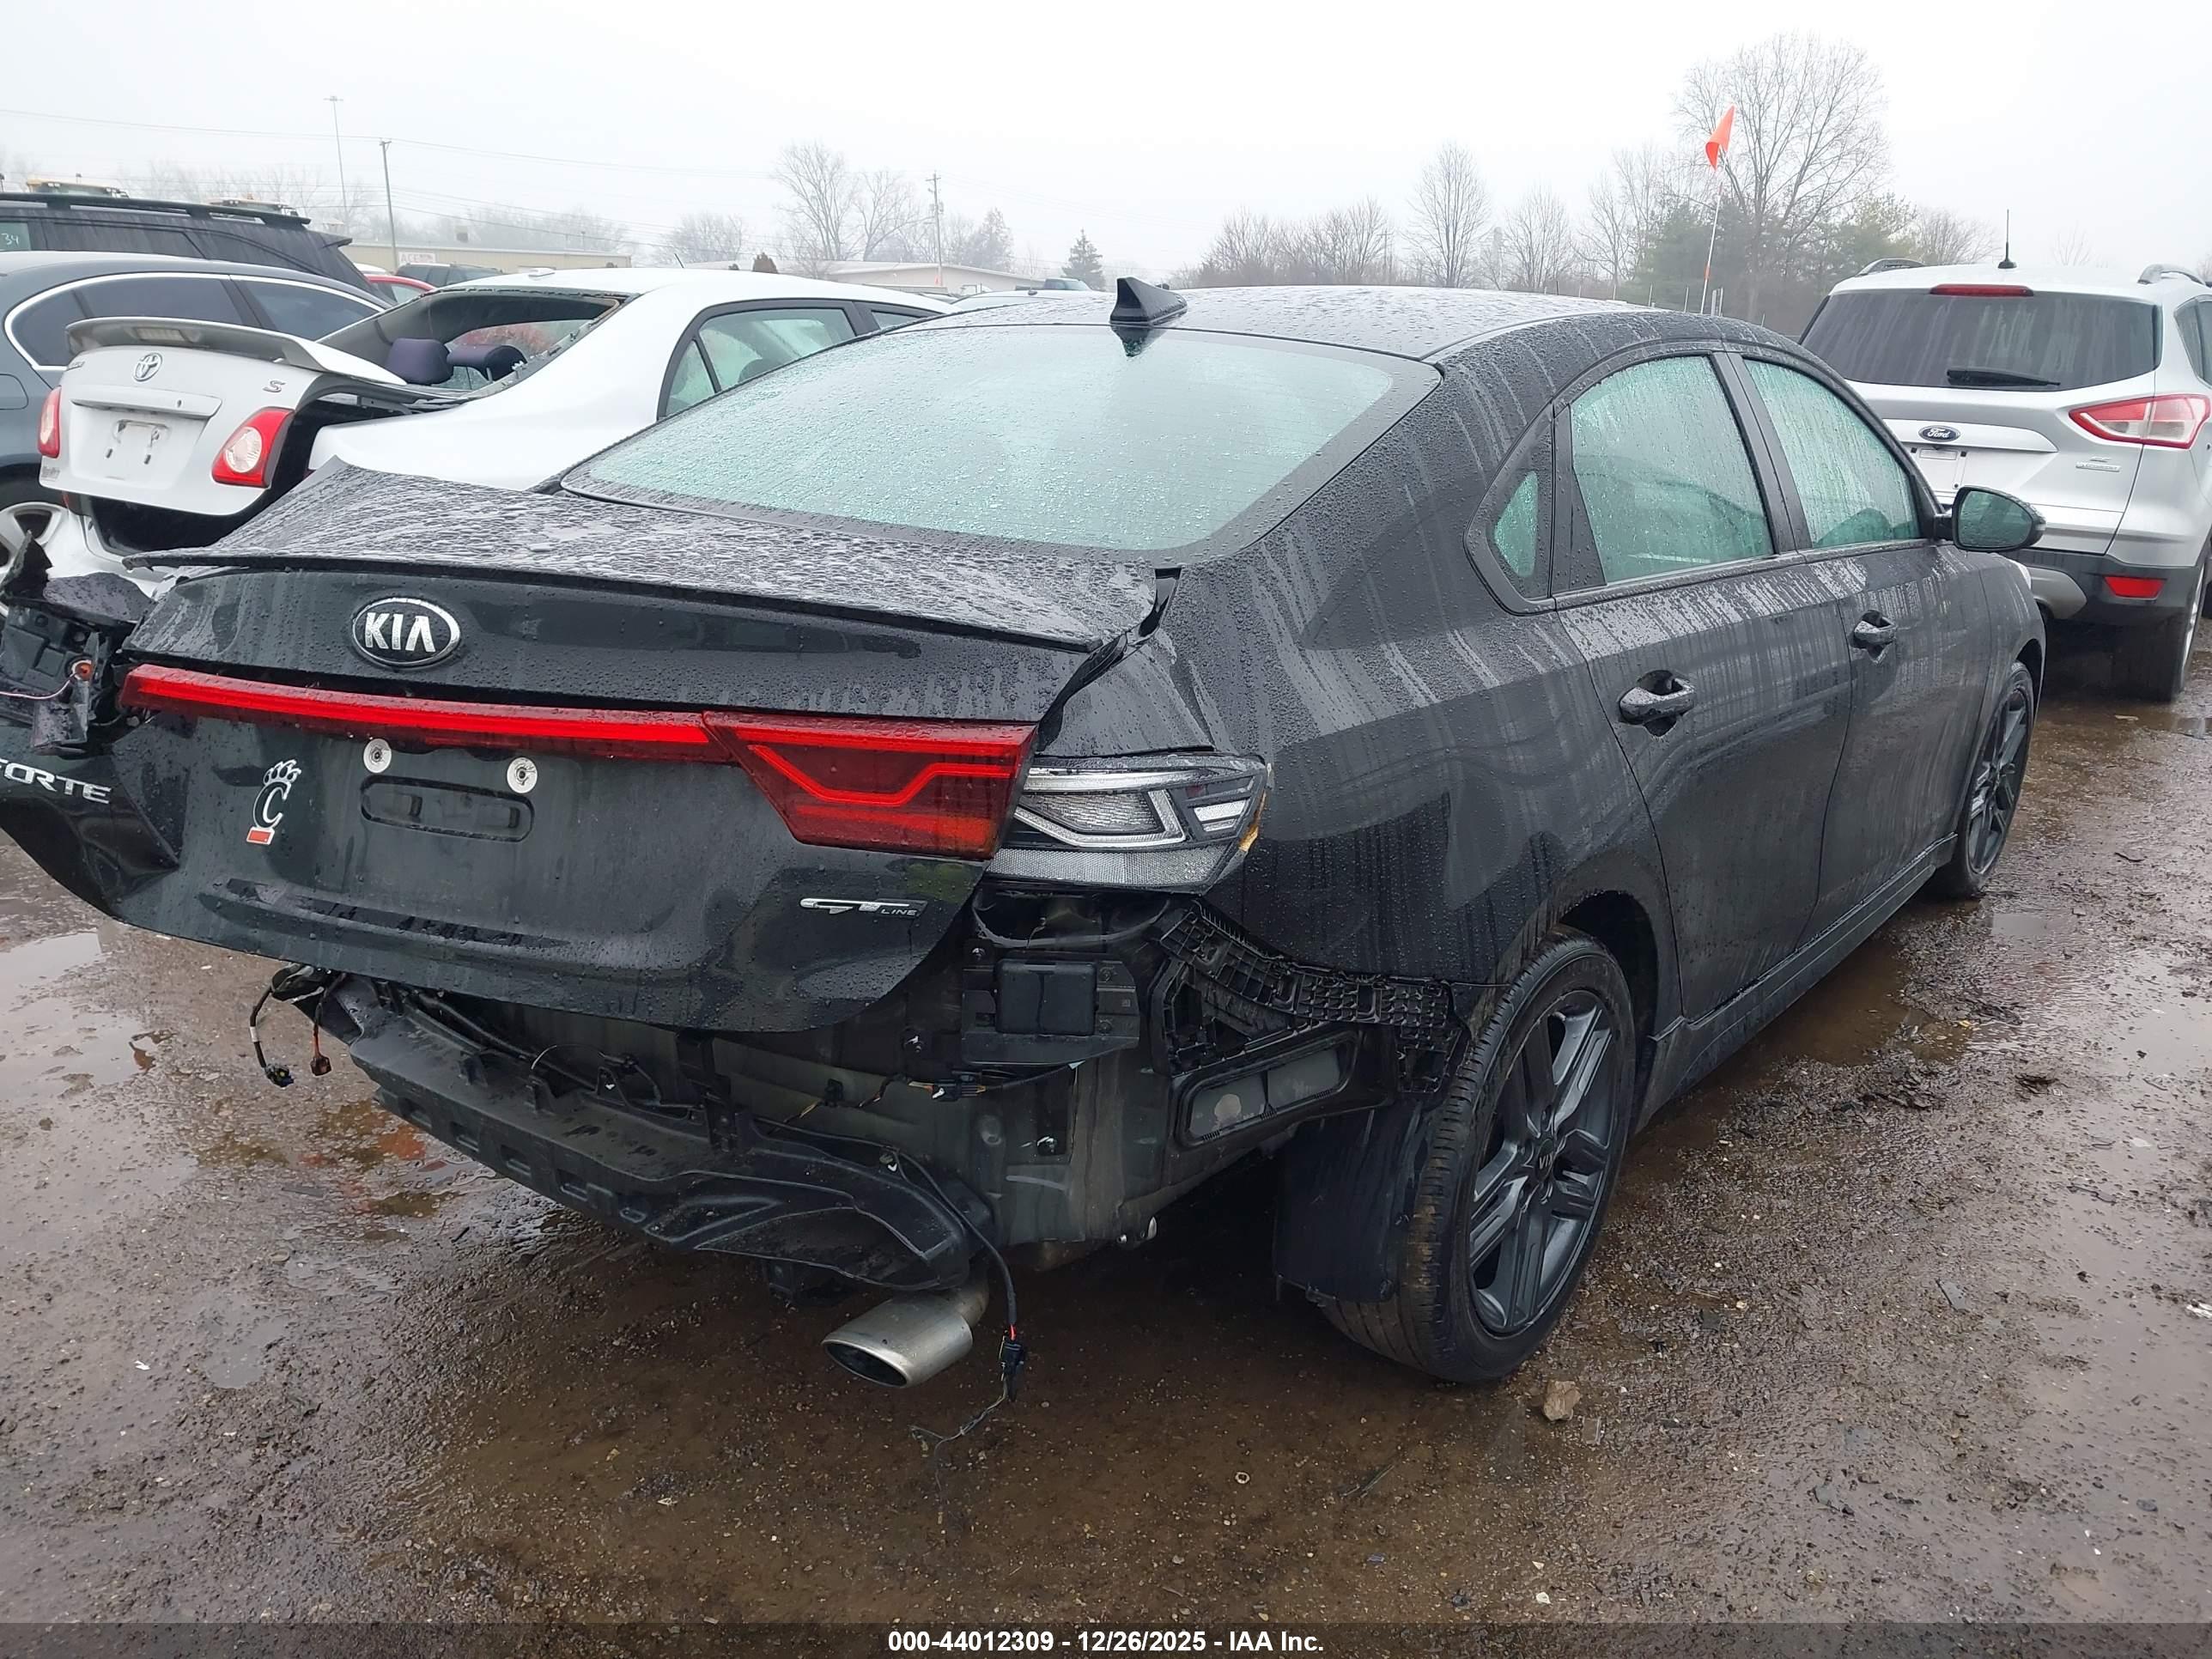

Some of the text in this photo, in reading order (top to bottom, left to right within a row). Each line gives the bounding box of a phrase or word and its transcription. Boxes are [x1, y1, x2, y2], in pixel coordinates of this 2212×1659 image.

[262, 380, 286, 393] S
[1927, 428, 1951, 438] Ford
[365, 611, 436, 653] KIA
